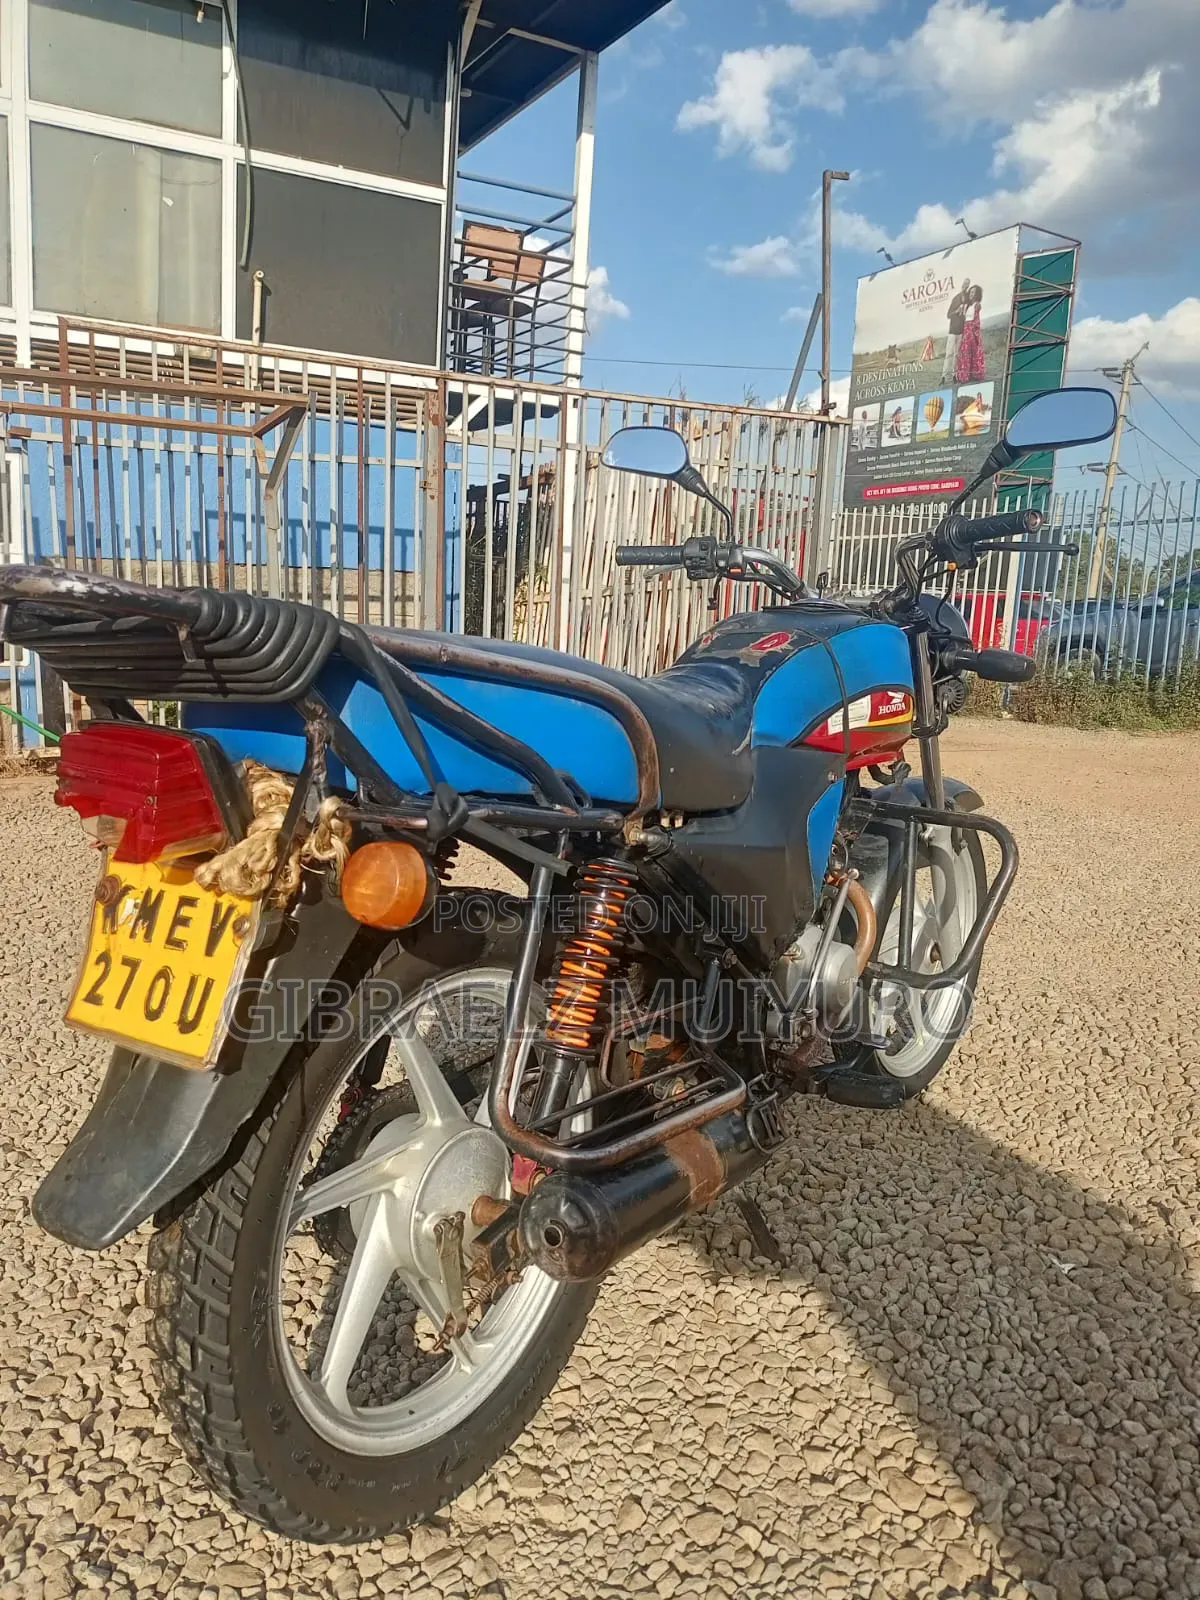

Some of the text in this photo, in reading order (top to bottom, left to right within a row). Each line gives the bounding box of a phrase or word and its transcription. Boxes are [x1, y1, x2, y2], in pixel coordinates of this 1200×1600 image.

[902, 276, 954, 304] SAROVA
[862, 361, 923, 385] DESTINATIONS
[855, 379, 915, 401] ACROSS KENYA
[878, 702, 906, 716] HONDA
[101, 883, 237, 957] KMEV
[82, 951, 216, 1035] 270U
